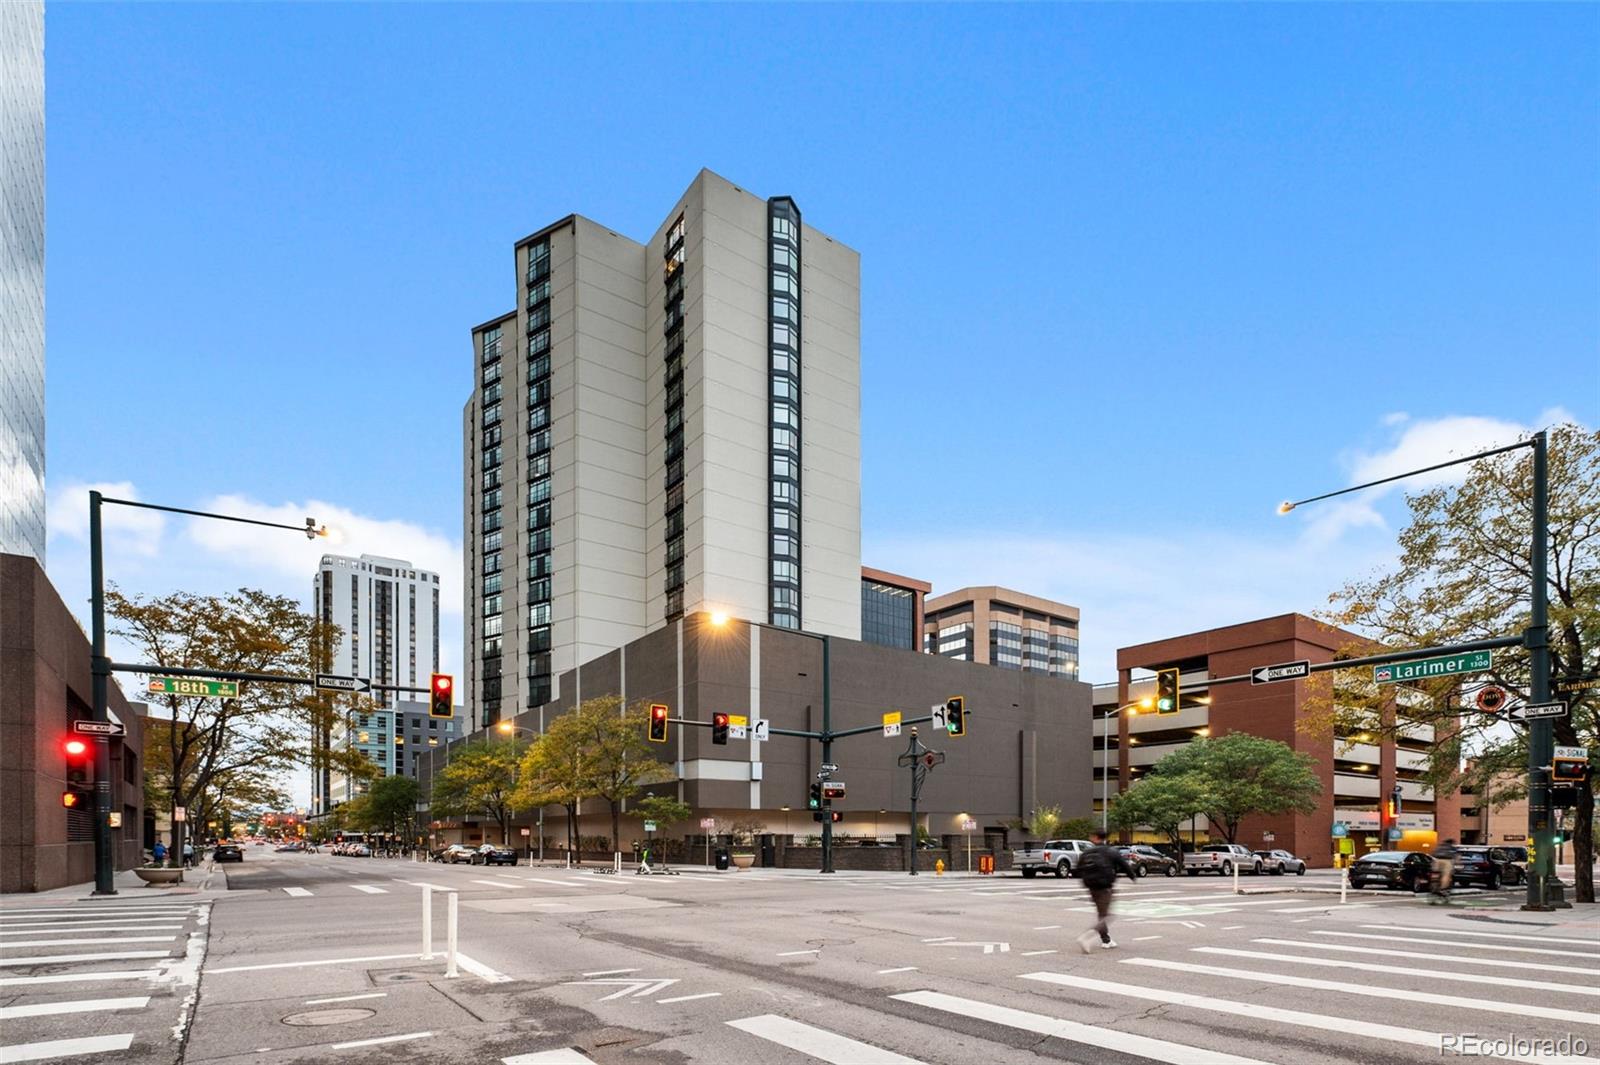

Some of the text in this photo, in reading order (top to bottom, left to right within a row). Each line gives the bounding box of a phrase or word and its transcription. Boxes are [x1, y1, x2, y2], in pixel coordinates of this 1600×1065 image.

[1268, 666, 1303, 678] ONE WAY
[1396, 658, 1465, 679] Larimer
[172, 680, 209, 694] 18th
[320, 678, 337, 686] ONE
[1543, 705, 1560, 713] WAY
[1567, 748, 1586, 758] SIGNAL
